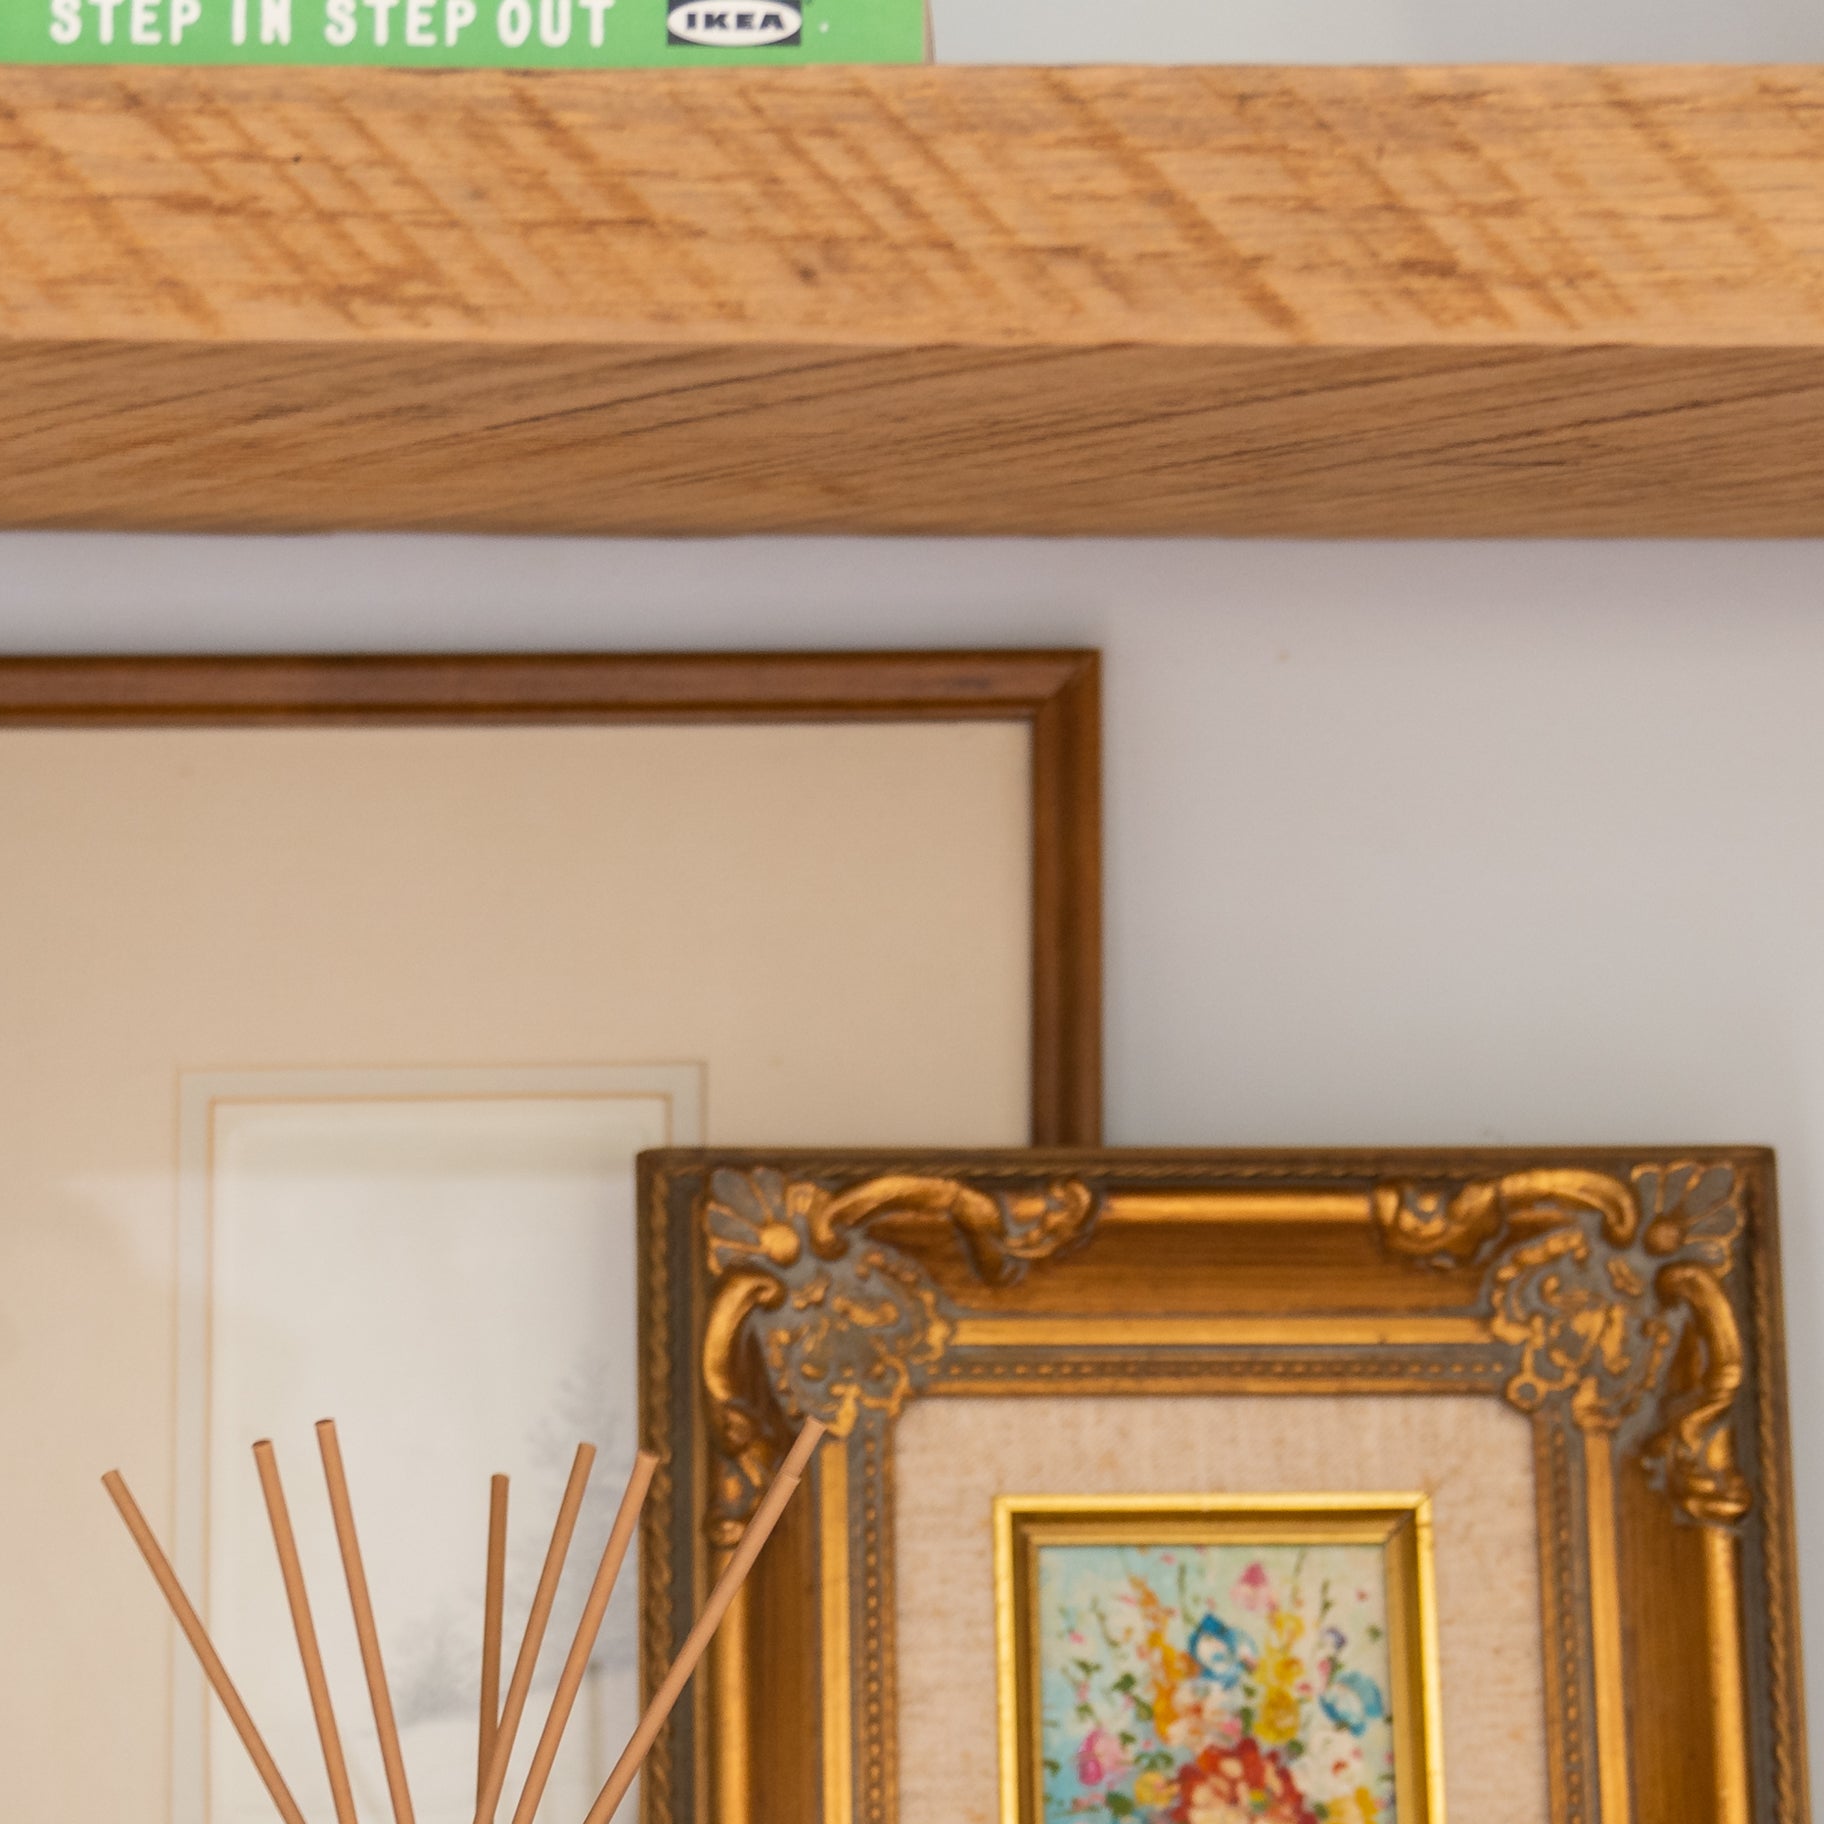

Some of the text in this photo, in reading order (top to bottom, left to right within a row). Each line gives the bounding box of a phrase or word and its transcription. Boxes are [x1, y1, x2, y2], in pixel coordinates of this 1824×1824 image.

[49, 0, 616, 48] STEP IN STEP OUT
[686, 13, 785, 30] IKEA
